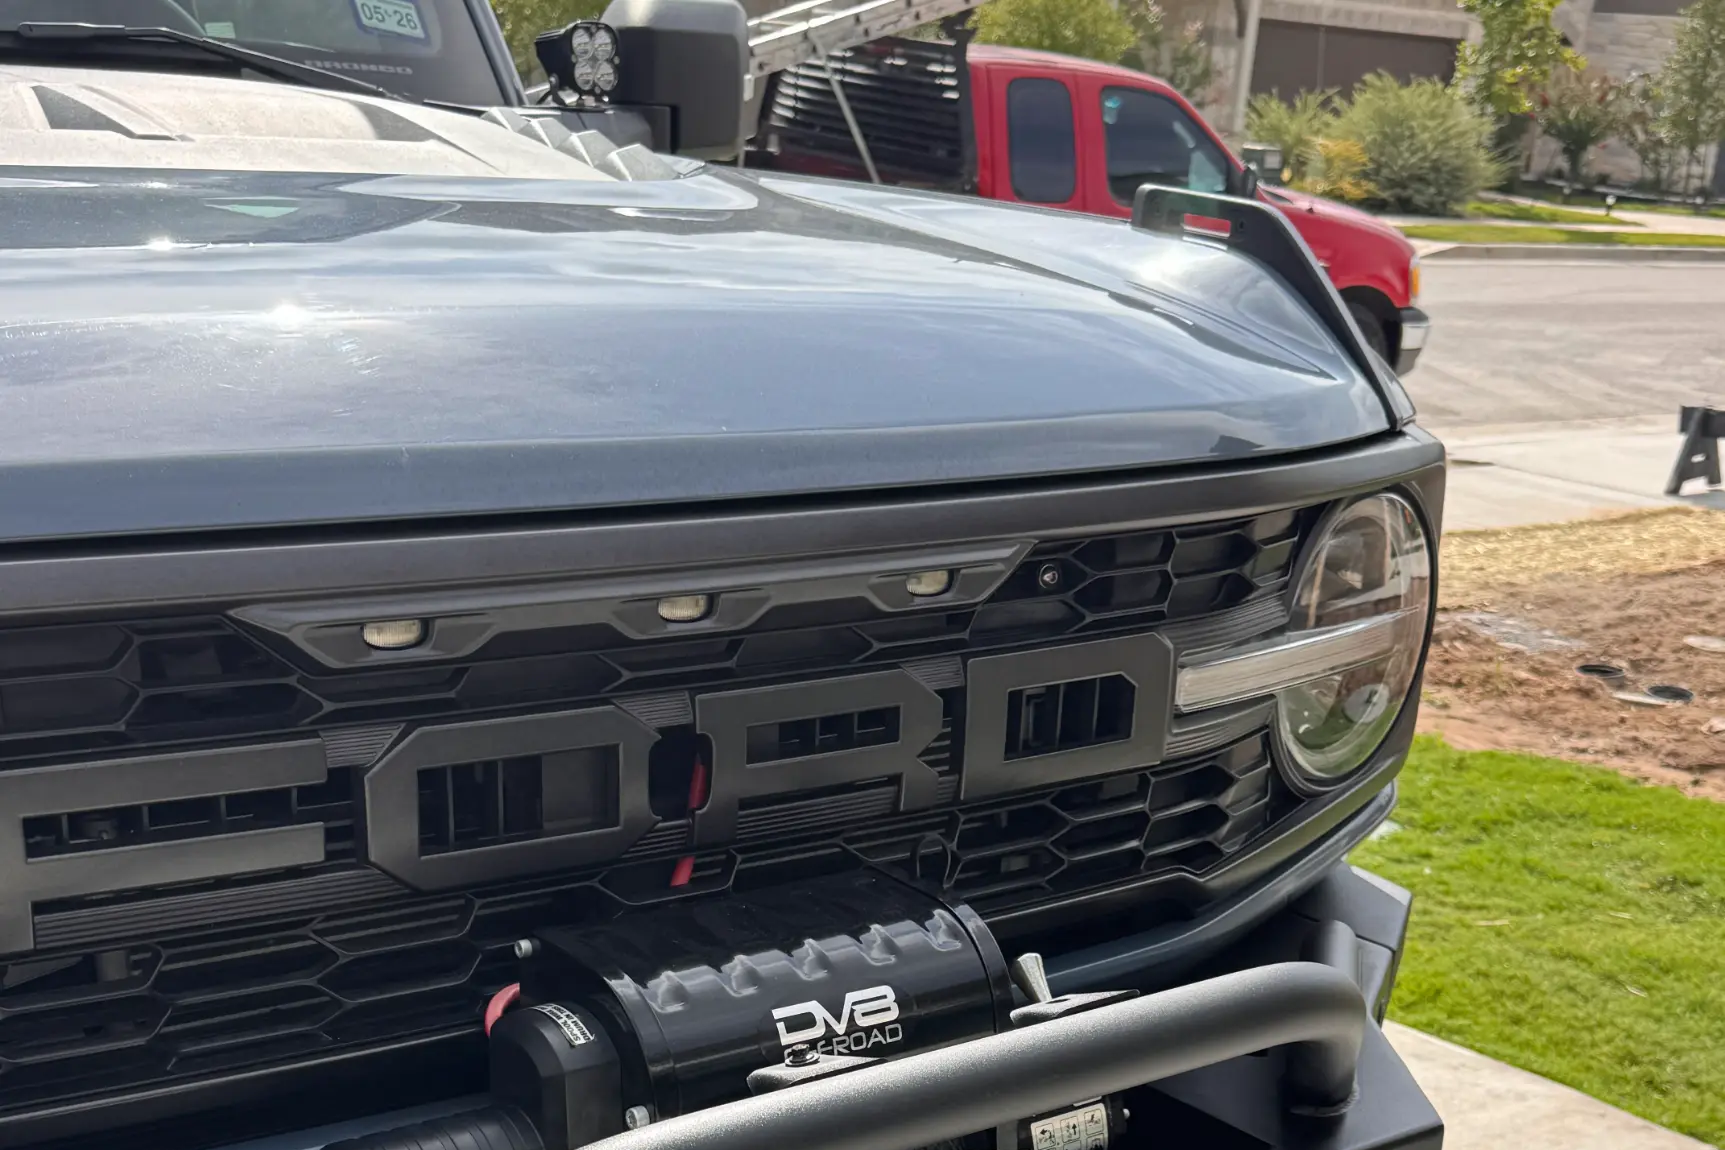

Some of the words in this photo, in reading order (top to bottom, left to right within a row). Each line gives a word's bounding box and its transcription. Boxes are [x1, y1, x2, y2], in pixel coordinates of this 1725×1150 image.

[360, 2, 386, 24] 05
[0, 632, 1174, 956] FORD
[771, 984, 900, 1047] DV8
[784, 1023, 903, 1059] FROAD
